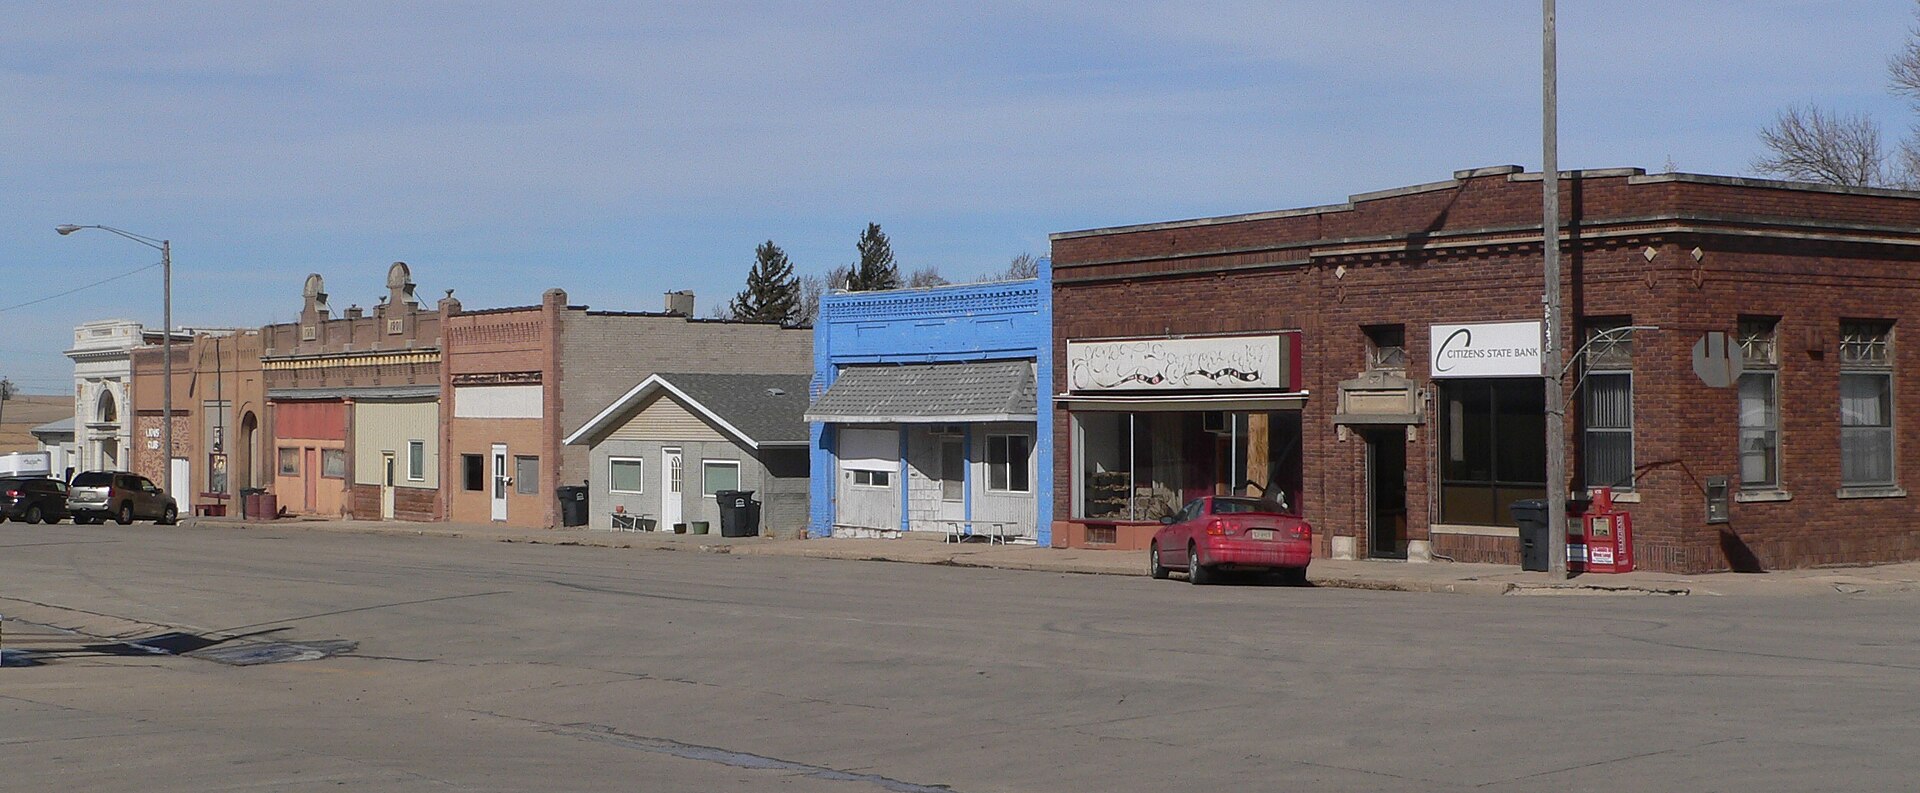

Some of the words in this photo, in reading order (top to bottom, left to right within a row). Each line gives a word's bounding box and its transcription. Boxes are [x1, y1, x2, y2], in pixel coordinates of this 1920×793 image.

[1447, 349, 1485, 359] CITIZENS
[1487, 349, 1512, 358] STATE
[1514, 348, 1538, 357] BANK
